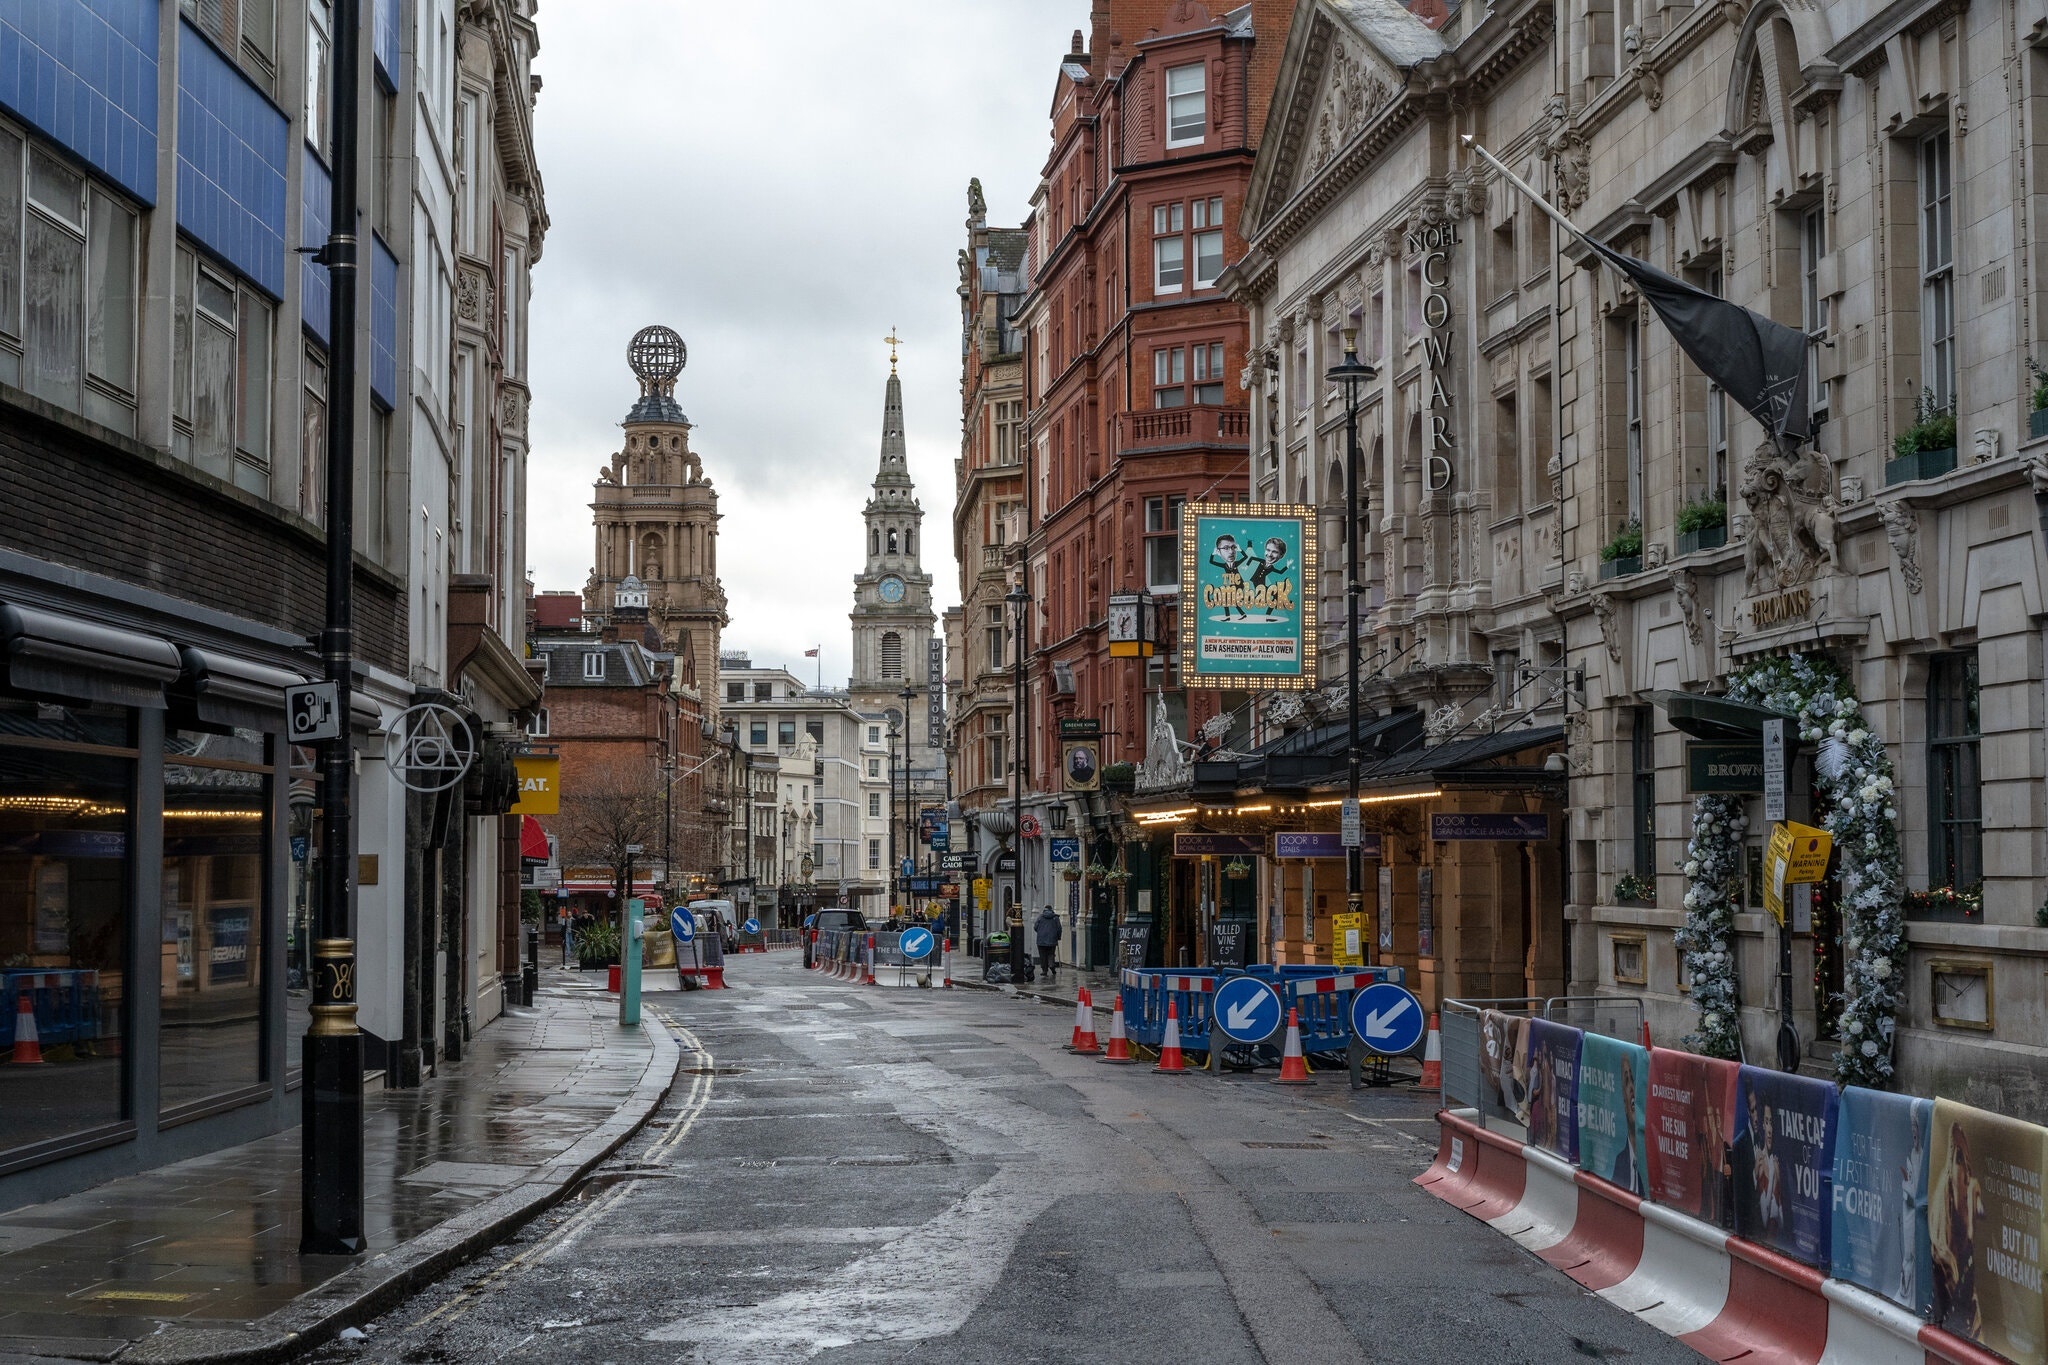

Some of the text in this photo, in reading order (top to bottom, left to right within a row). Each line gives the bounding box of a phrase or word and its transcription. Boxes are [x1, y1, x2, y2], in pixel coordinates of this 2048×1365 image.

[1408, 223, 1463, 253] NOËL
[1421, 252, 1455, 492] COWARD
[1752, 589, 1810, 626] BROWNS
[1204, 644, 1217, 653] BEN
[1218, 644, 1252, 653] ASHENDEN
[1258, 645, 1274, 653] ALEX
[1276, 646, 1293, 654] OWEN
[931, 641, 940, 683] DUKE
[1708, 764, 1764, 776] BROWN
[1436, 816, 1479, 826] DOOR C
[1280, 836, 1319, 845] DOOR B
[1792, 859, 1825, 868] WARNING
[1213, 924, 1241, 935] MULLED
[1217, 936, 1236, 945] WINE
[1579, 1066, 1615, 1092] THIS PLACE
[1652, 1084, 1691, 1105] DARKEST NIGHT
[1577, 1102, 1616, 1138] BELONG
[1661, 1115, 1687, 1138] THE SUN
[1778, 1108, 1805, 1142] TAKE
[1658, 1135, 1688, 1160] WILL RISE
[1794, 1163, 1819, 1201] YOU
[2010, 1164, 2029, 1185] BUILD
[2029, 1170, 2039, 1189] ME
[2008, 1184, 2024, 1204] TEAR
[2024, 1189, 2032, 1207] ME
[2002, 1225, 2038, 1263] BUT I'M
